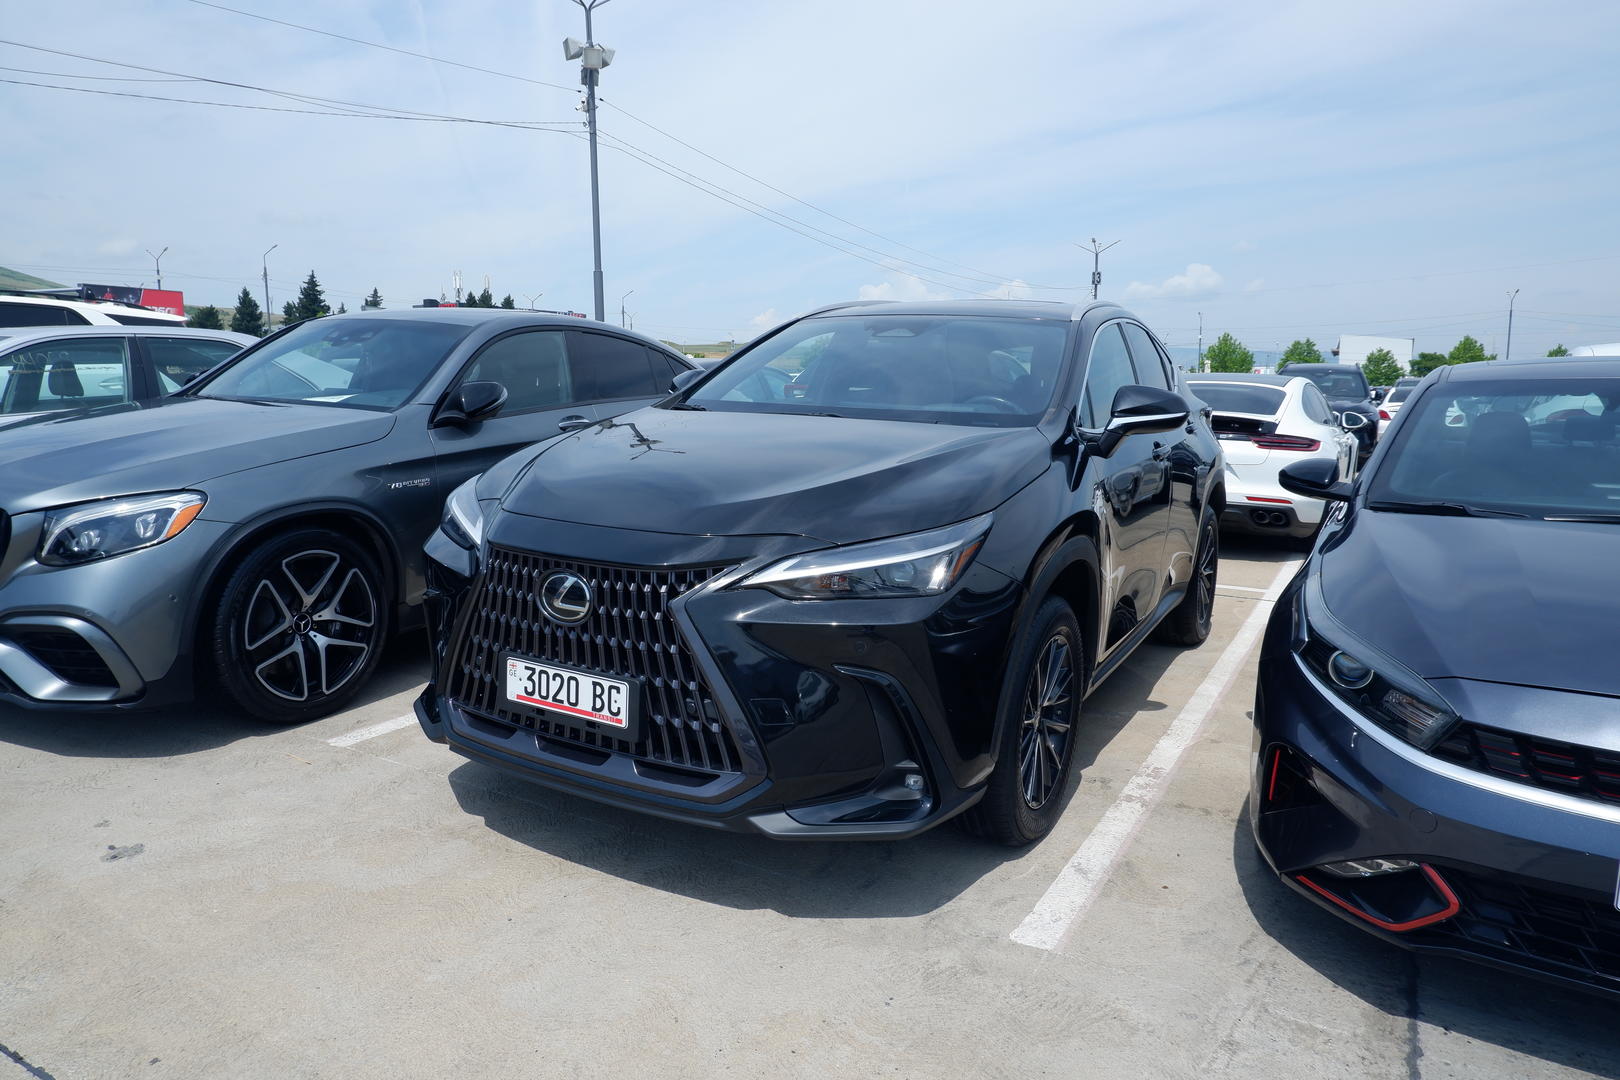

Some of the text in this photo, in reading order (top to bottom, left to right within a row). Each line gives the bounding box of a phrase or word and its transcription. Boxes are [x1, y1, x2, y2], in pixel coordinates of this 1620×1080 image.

[508, 669, 517, 678] GE
[524, 665, 621, 717] 3020 BC
